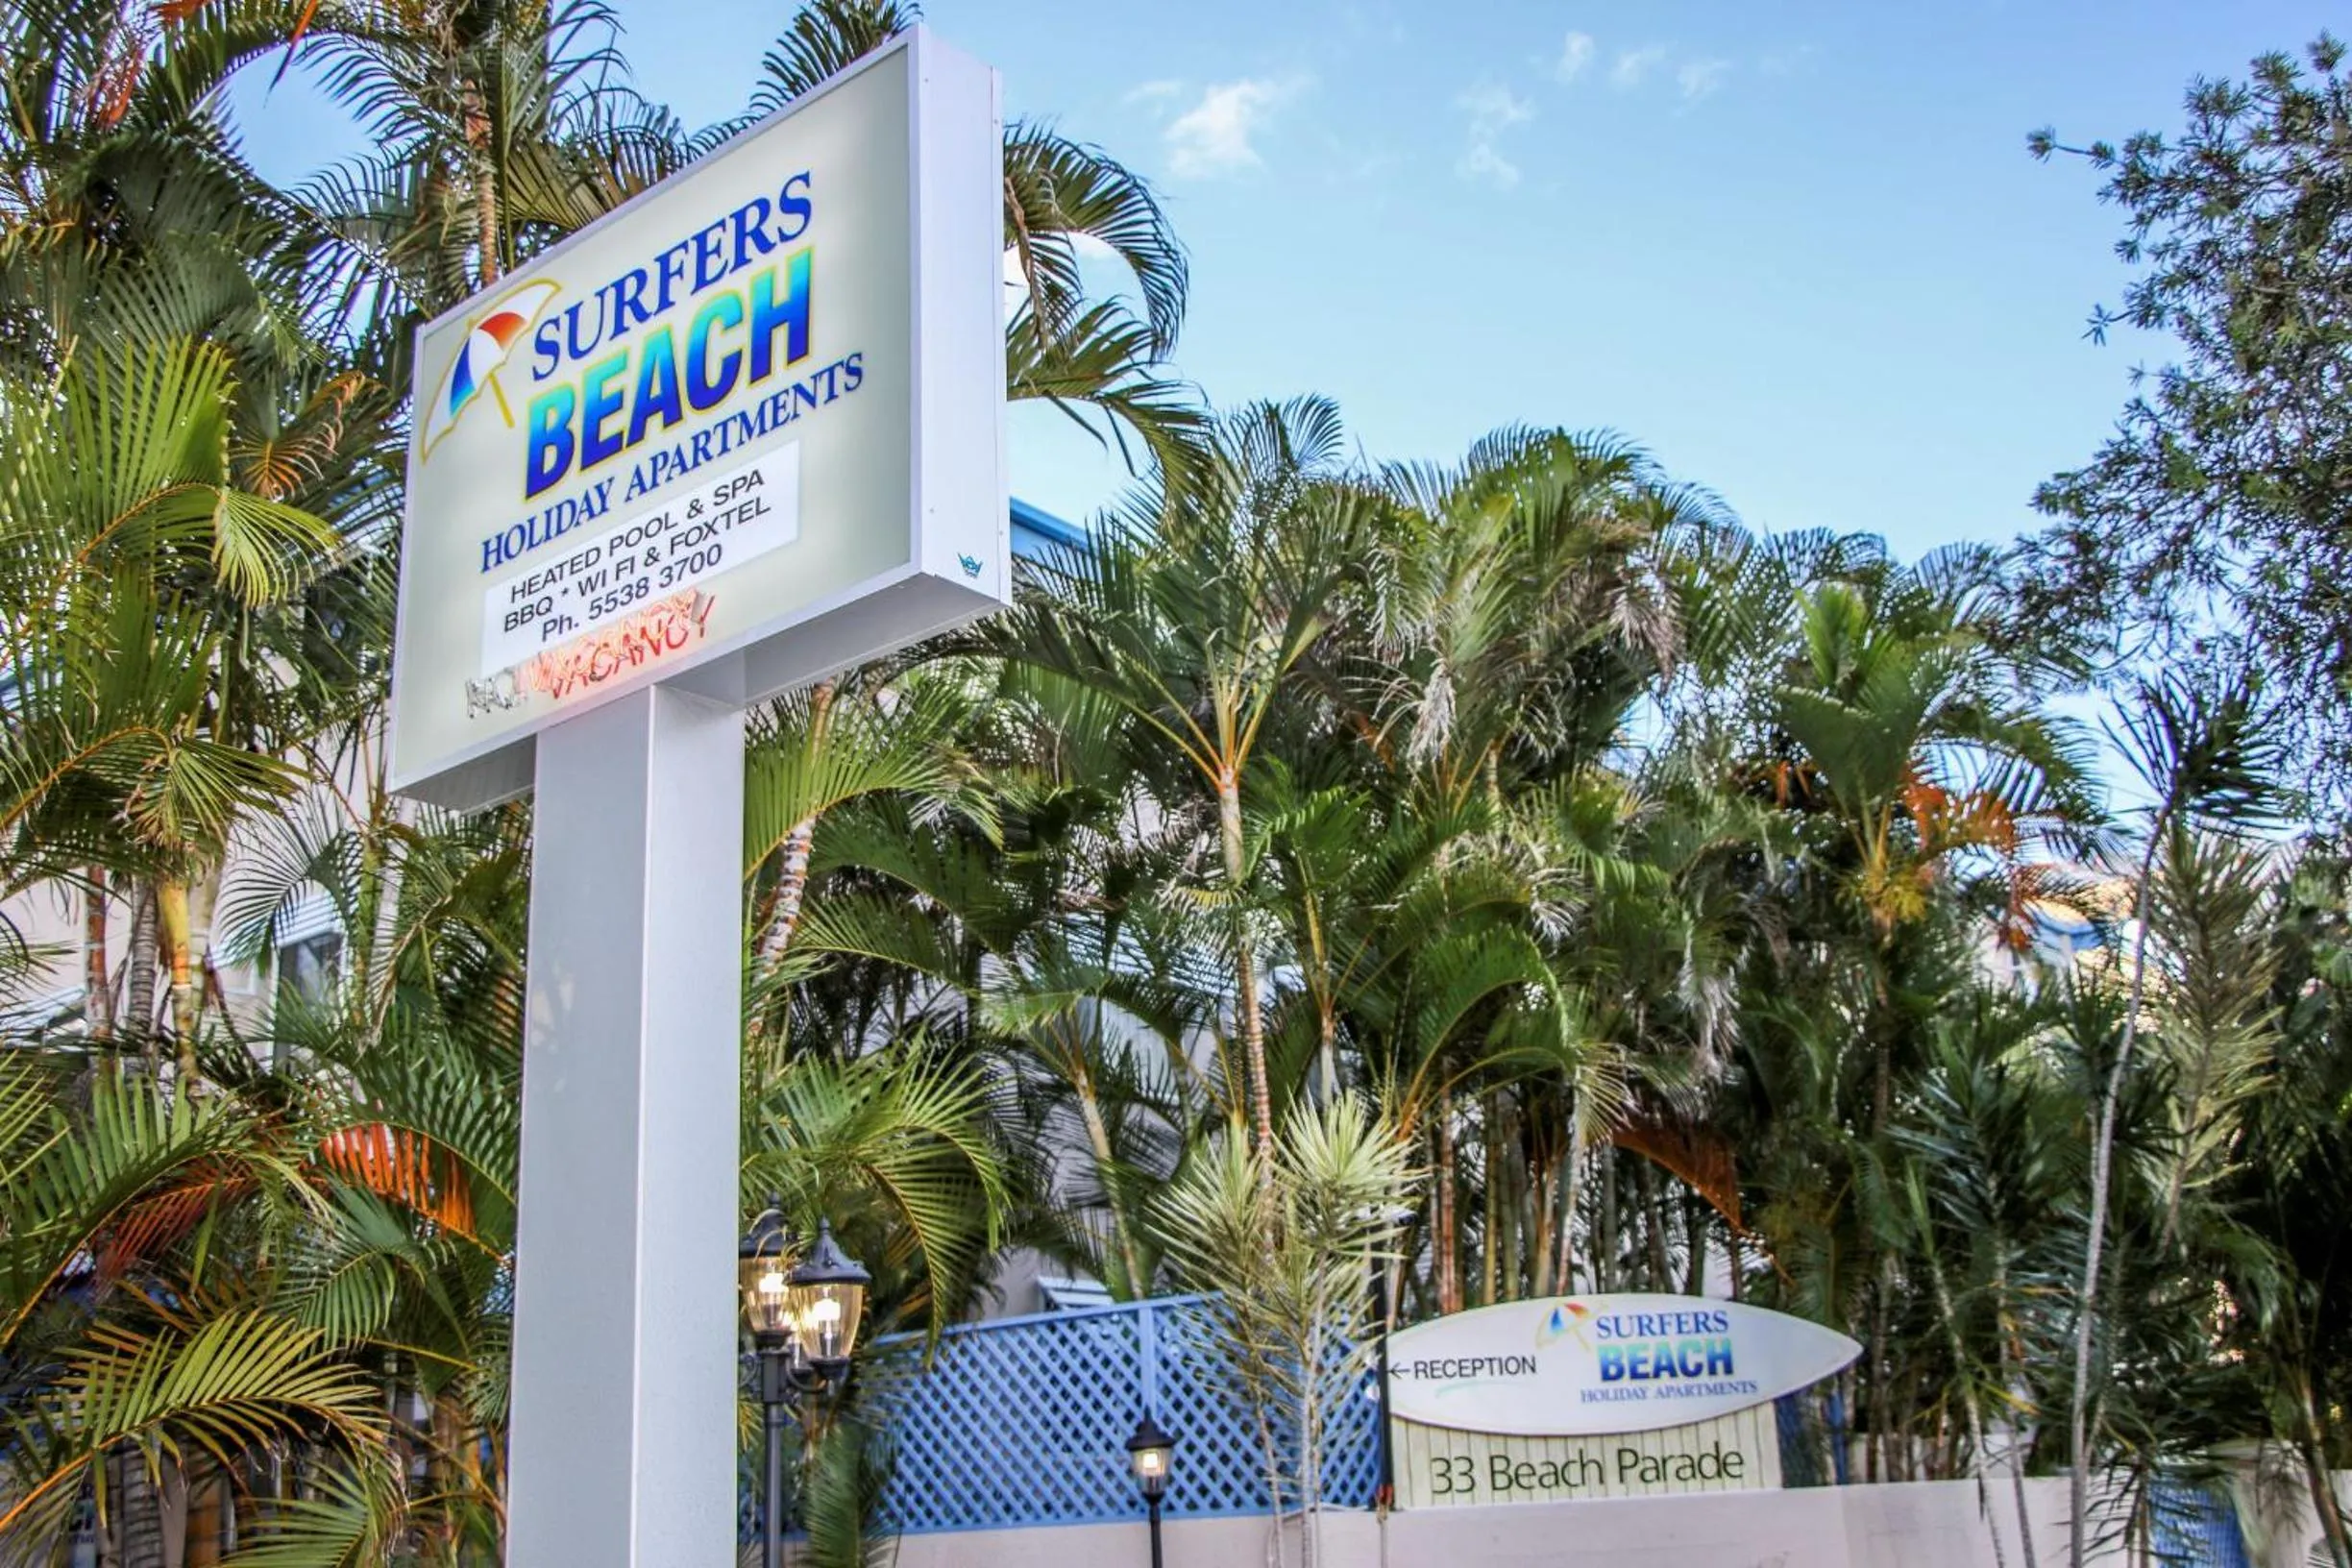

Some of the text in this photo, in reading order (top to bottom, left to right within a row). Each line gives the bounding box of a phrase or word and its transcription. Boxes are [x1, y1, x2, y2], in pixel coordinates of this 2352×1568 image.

[531, 171, 813, 380] SURFERS
[524, 246, 816, 502] BEACH
[480, 353, 865, 575] HOLIDAY APARTMENTS
[503, 599, 554, 633] BBQ
[576, 571, 609, 598] WI
[616, 557, 636, 581] FI
[644, 547, 661, 567] &
[671, 497, 772, 555] FOXTEL
[510, 468, 765, 603] HEATED POOL & SPA
[588, 577, 650, 621] 5538
[658, 543, 723, 591] 3700
[1597, 1311, 1728, 1336] SURFERS
[1599, 1340, 1734, 1381] BEACH
[1414, 1355, 1536, 1380] RECEPTION
[1580, 1380, 1758, 1403] HOLIDAY APARTMENTS
[1432, 1442, 1745, 1495] 33 Beach Parade
